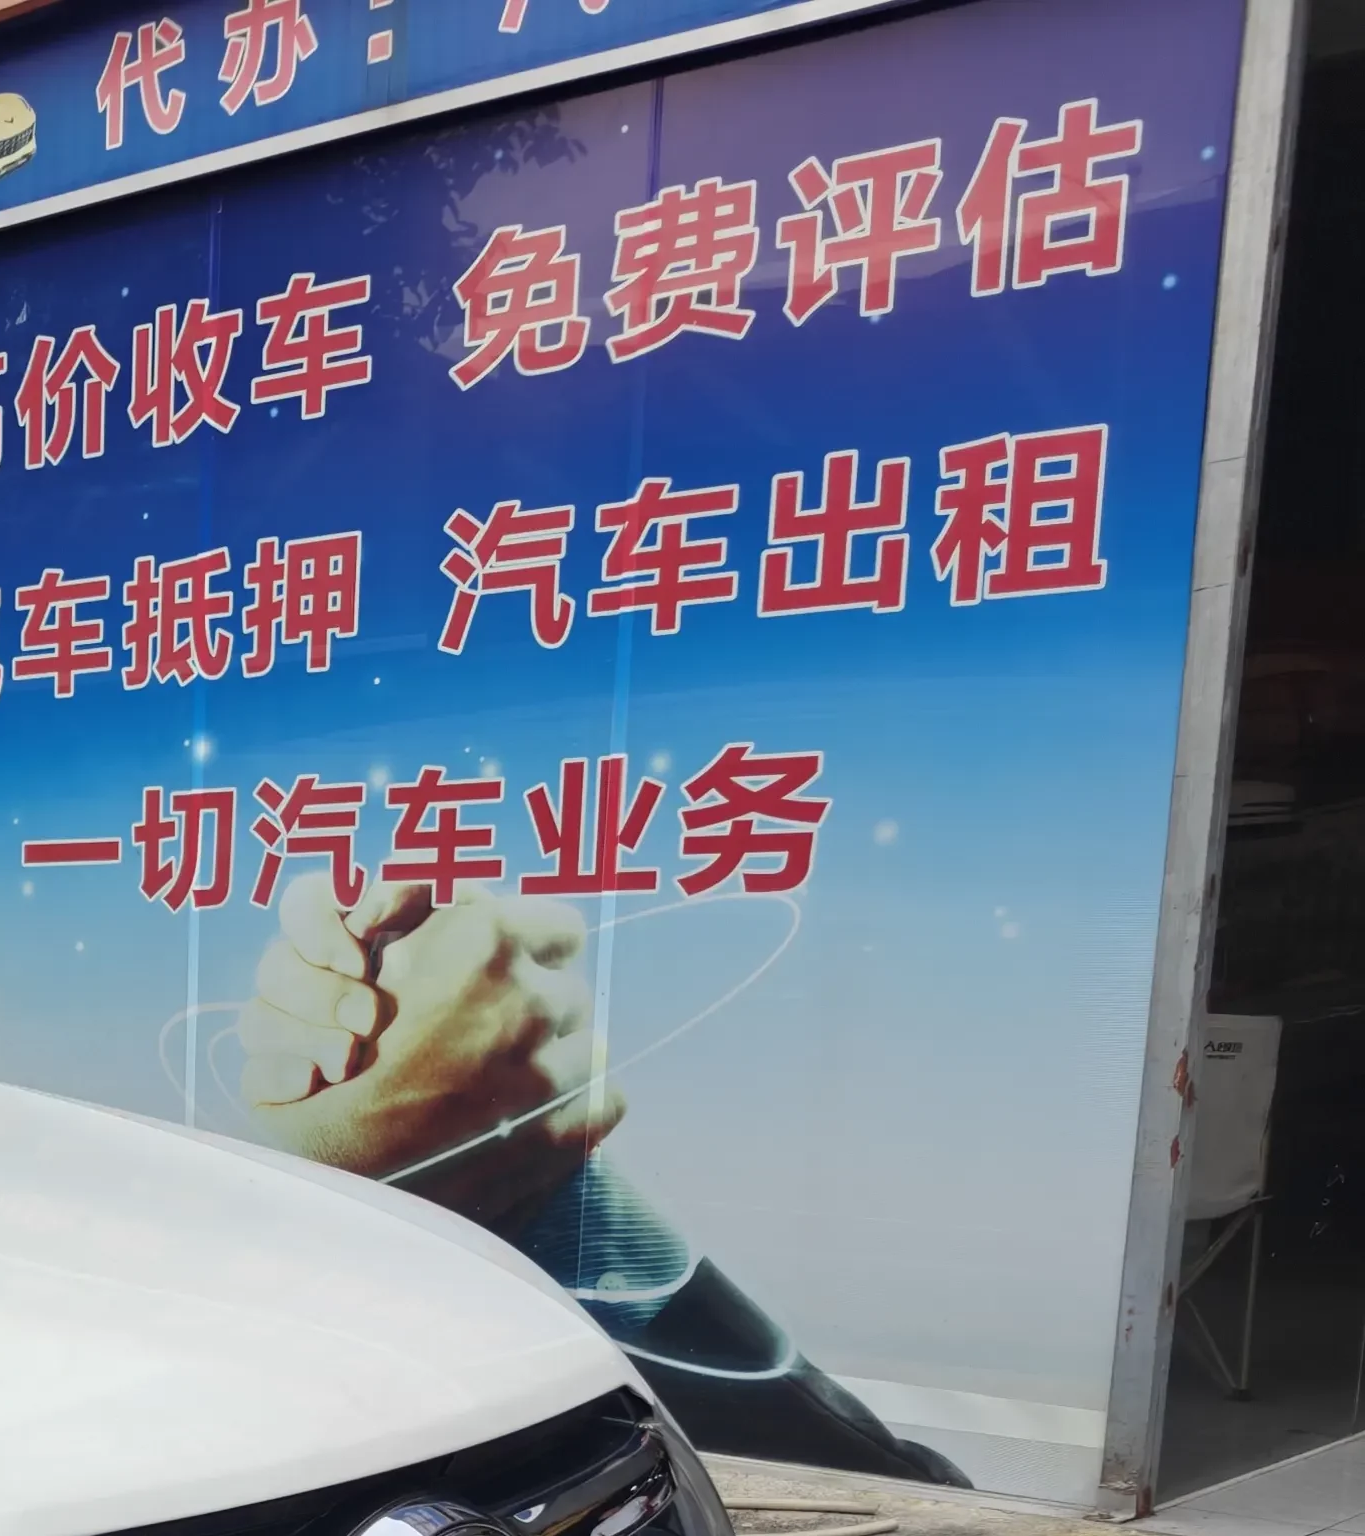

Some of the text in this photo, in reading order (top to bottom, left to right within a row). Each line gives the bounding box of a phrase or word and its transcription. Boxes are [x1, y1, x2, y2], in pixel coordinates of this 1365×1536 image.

[448, 98, 1142, 391] 免费评估
[437, 423, 1108, 656] 汽车出租
[20, 742, 832, 912] 一切汽车业务
